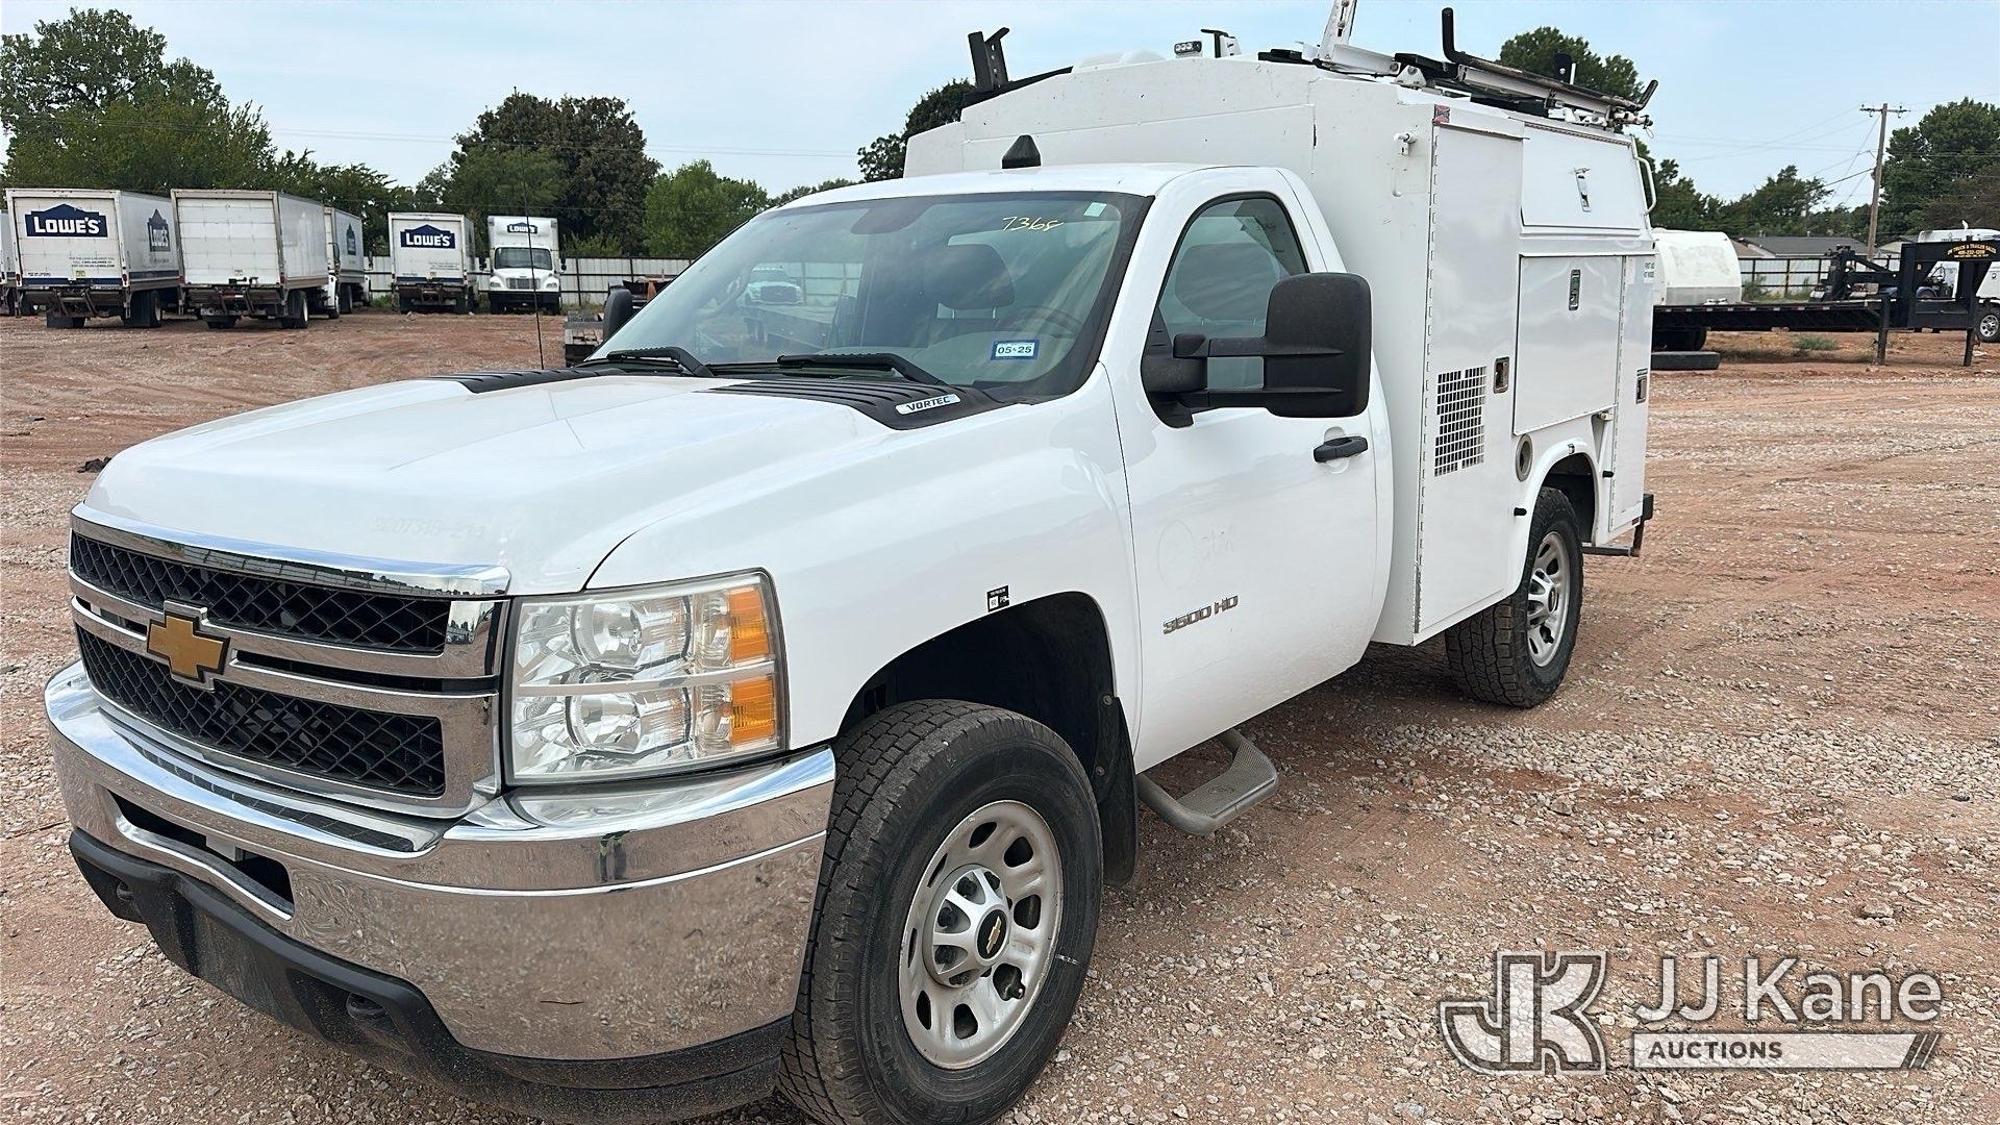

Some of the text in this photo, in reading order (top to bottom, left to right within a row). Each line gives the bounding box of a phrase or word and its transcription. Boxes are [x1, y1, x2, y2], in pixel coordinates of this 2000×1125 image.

[34, 216, 99, 233] LOWE'S
[406, 233, 450, 246] LOWE'S
[906, 396, 950, 411] VORTEC
[1214, 595, 1239, 615] HD
